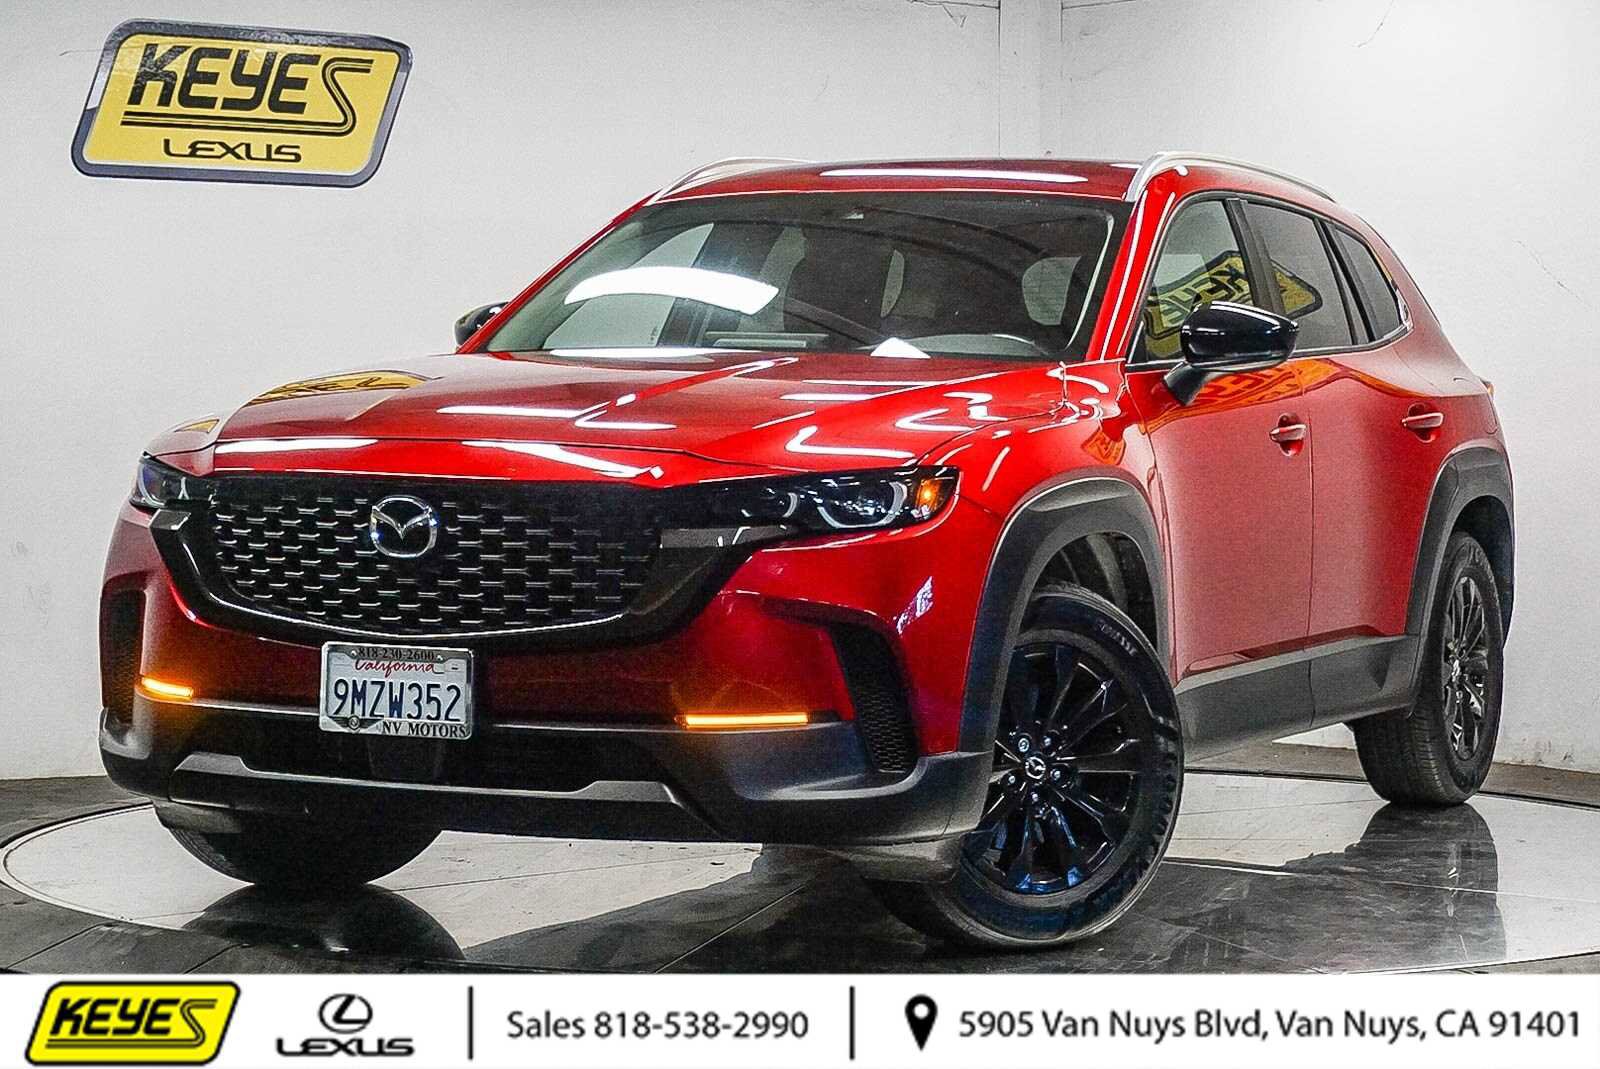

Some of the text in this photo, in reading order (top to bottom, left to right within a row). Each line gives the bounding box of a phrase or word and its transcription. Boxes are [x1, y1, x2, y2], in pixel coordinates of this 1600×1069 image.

[122, 43, 373, 137] KEYES
[163, 139, 301, 162] LEXUS
[358, 648, 435, 660] 818-230-2600
[355, 660, 437, 677] California
[333, 678, 462, 722] 9MZW352
[382, 721, 466, 738] NV MOTORS
